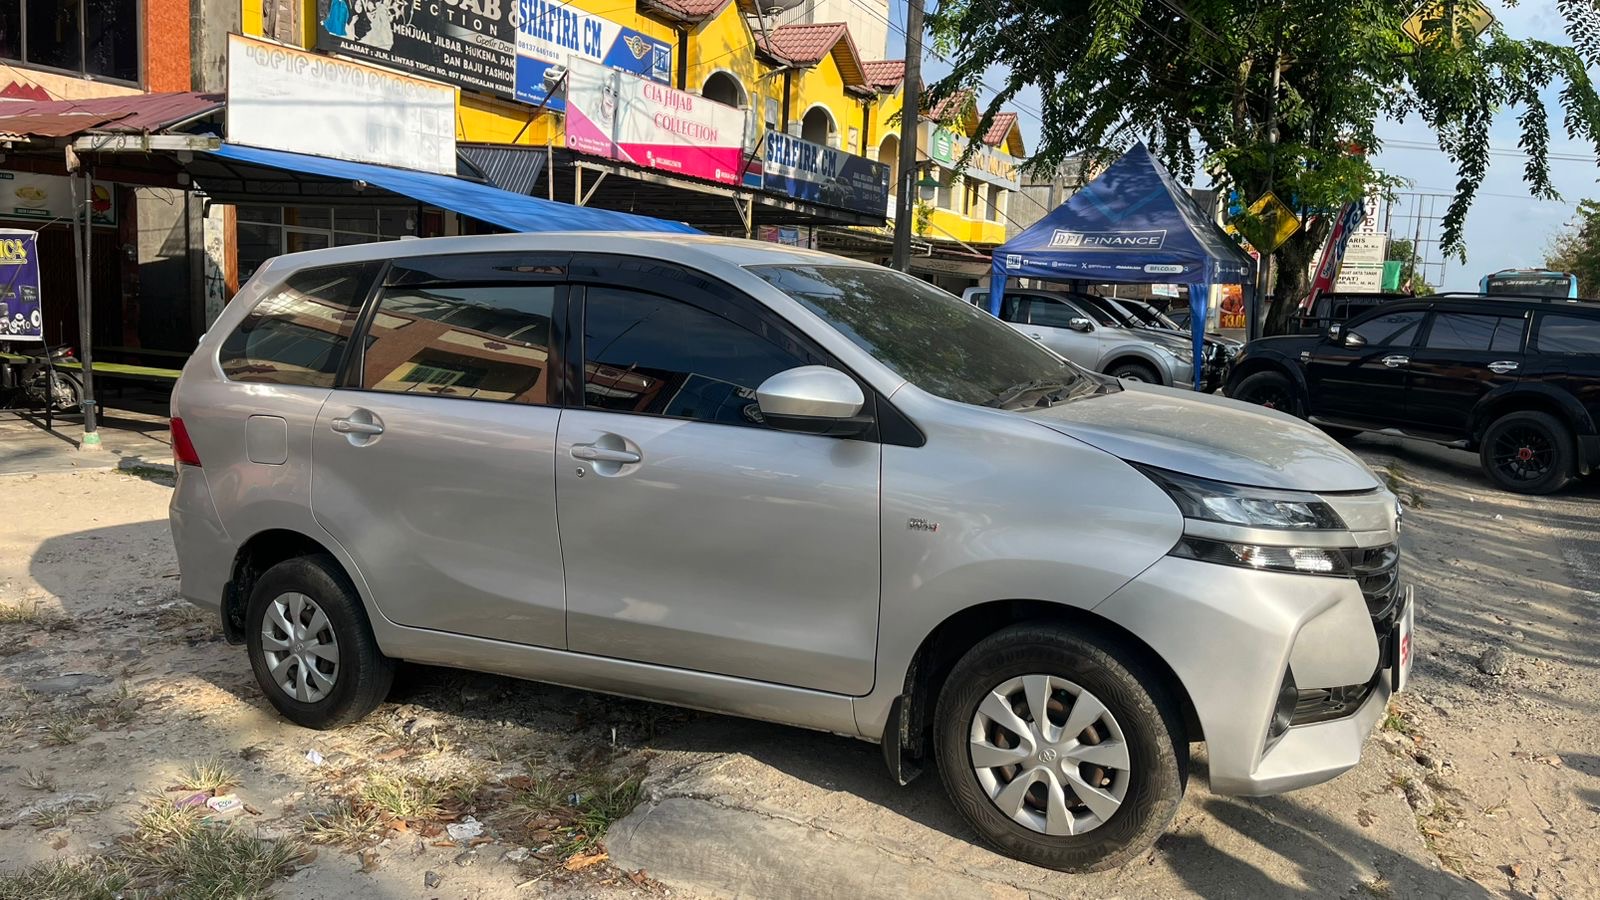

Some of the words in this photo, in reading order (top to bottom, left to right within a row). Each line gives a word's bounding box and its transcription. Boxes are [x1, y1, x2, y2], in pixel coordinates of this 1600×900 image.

[393, 23, 432, 44] MENJUAL
[518, 0, 579, 51] SHAFIRA
[584, 17, 602, 59] CM
[498, 42, 514, 54] Dan
[339, 41, 369, 55] ALAMAT
[391, 54, 415, 68] LINTAS
[415, 61, 437, 74] TIMUR
[437, 67, 448, 77] NO.
[460, 73, 494, 89] PANGKALAN
[444, 53, 461, 67] DAN
[463, 58, 483, 73] BAJU
[484, 64, 515, 82] FASHION
[643, 83, 662, 103] CIA
[664, 89, 692, 111] HIJAB
[654, 112, 717, 142] COLLECTION
[767, 132, 818, 174] SHAFIRA
[821, 149, 837, 179] CM
[1057, 233, 1082, 245] BFI
[1083, 236, 1161, 245] FINANCE
